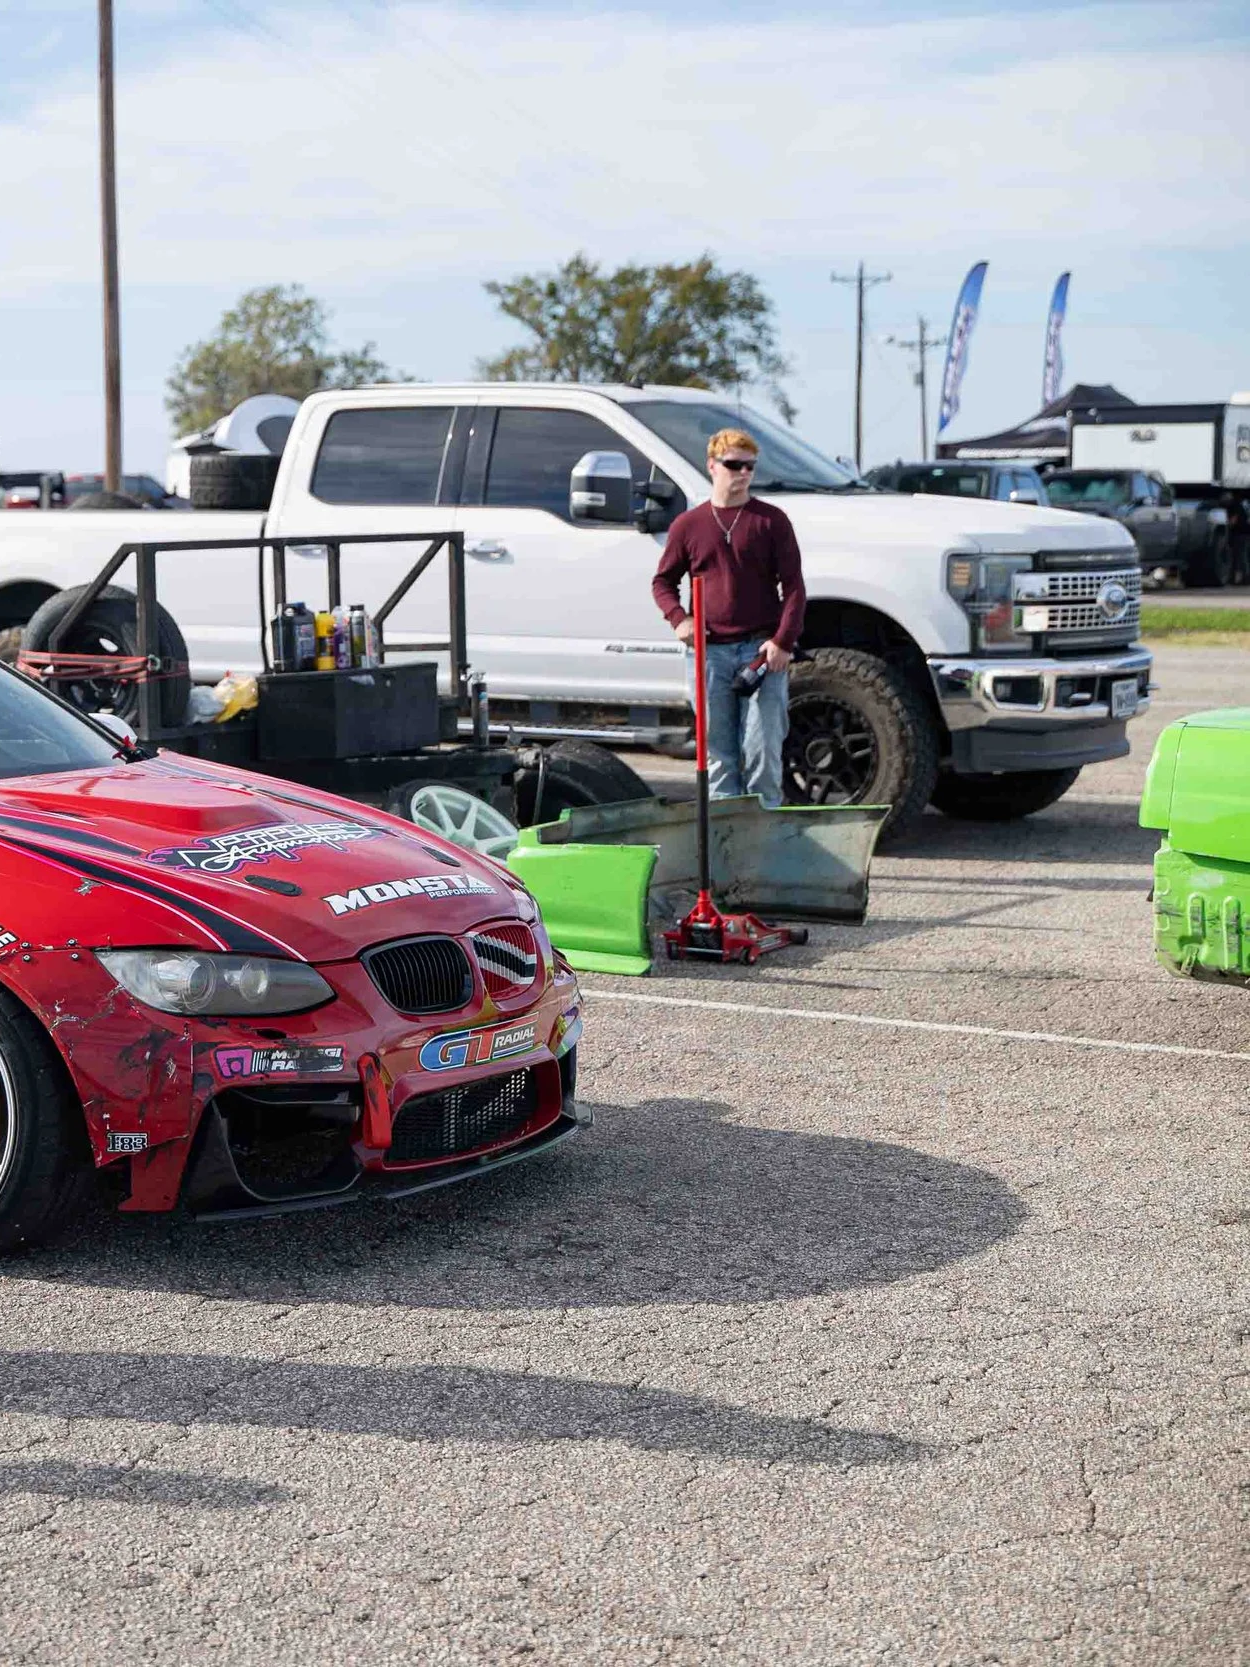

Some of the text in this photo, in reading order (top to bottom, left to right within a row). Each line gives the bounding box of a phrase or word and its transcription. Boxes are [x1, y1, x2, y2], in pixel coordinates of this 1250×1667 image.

[322, 873, 493, 915] MONSTA
[428, 887, 498, 899] PERFORMANCE
[418, 1026, 535, 1072] GT RADIAL
